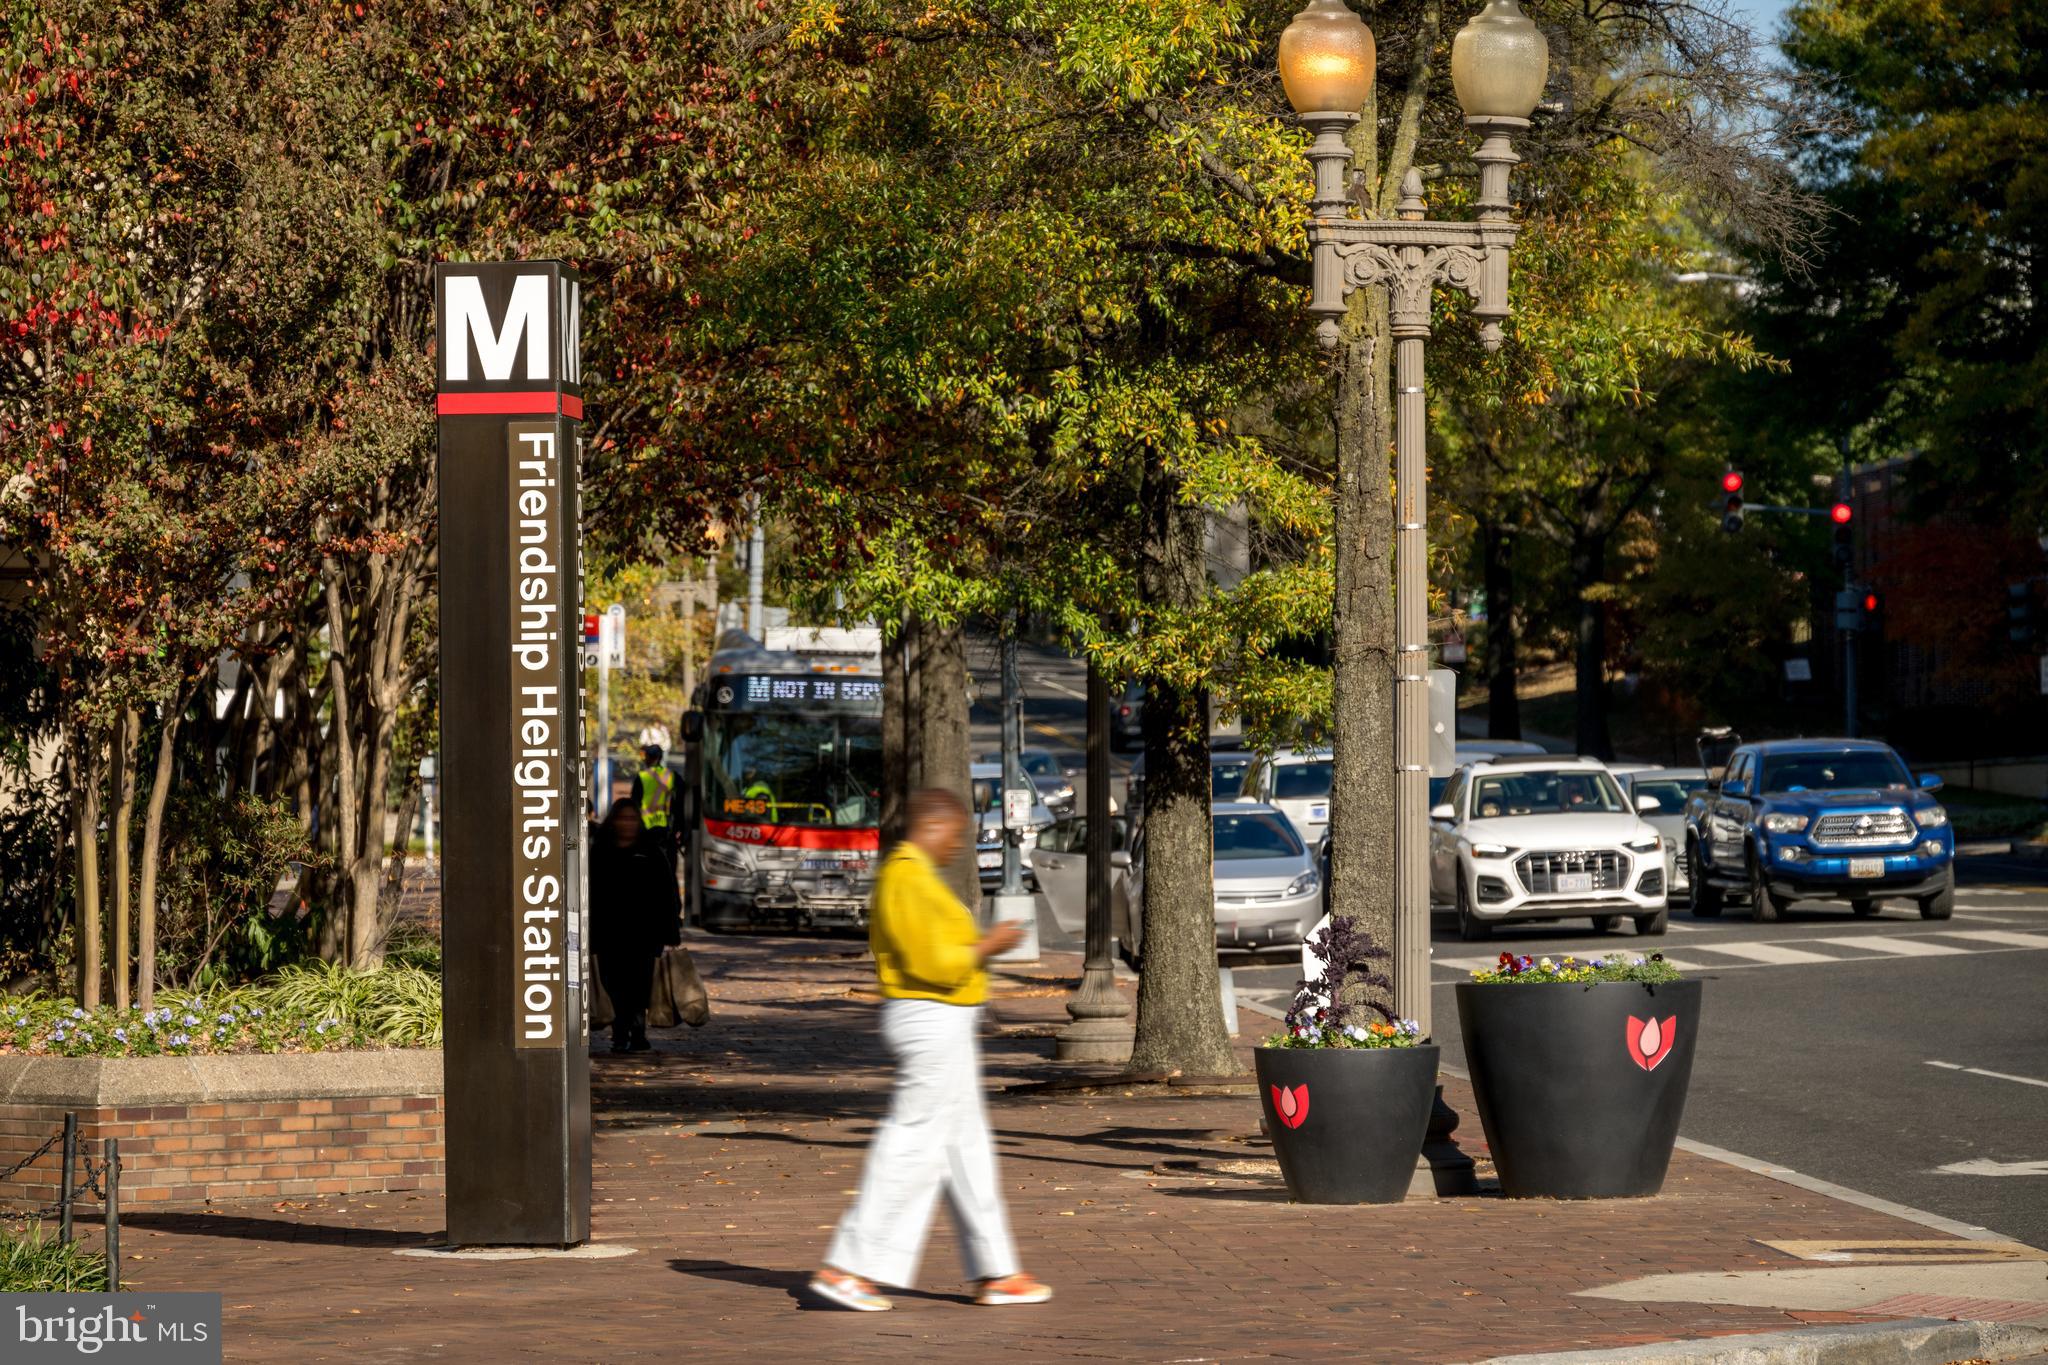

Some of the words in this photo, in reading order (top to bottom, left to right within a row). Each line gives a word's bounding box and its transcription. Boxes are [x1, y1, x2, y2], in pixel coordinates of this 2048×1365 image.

[445, 274, 549, 381] M
[560, 276, 580, 385] M
[511, 432, 556, 671] Friendship
[576, 437, 585, 673] Friendship
[773, 681, 808, 698] NOT
[813, 681, 836, 699] IN
[514, 686, 558, 859] Heights
[522, 875, 560, 1039] Station
